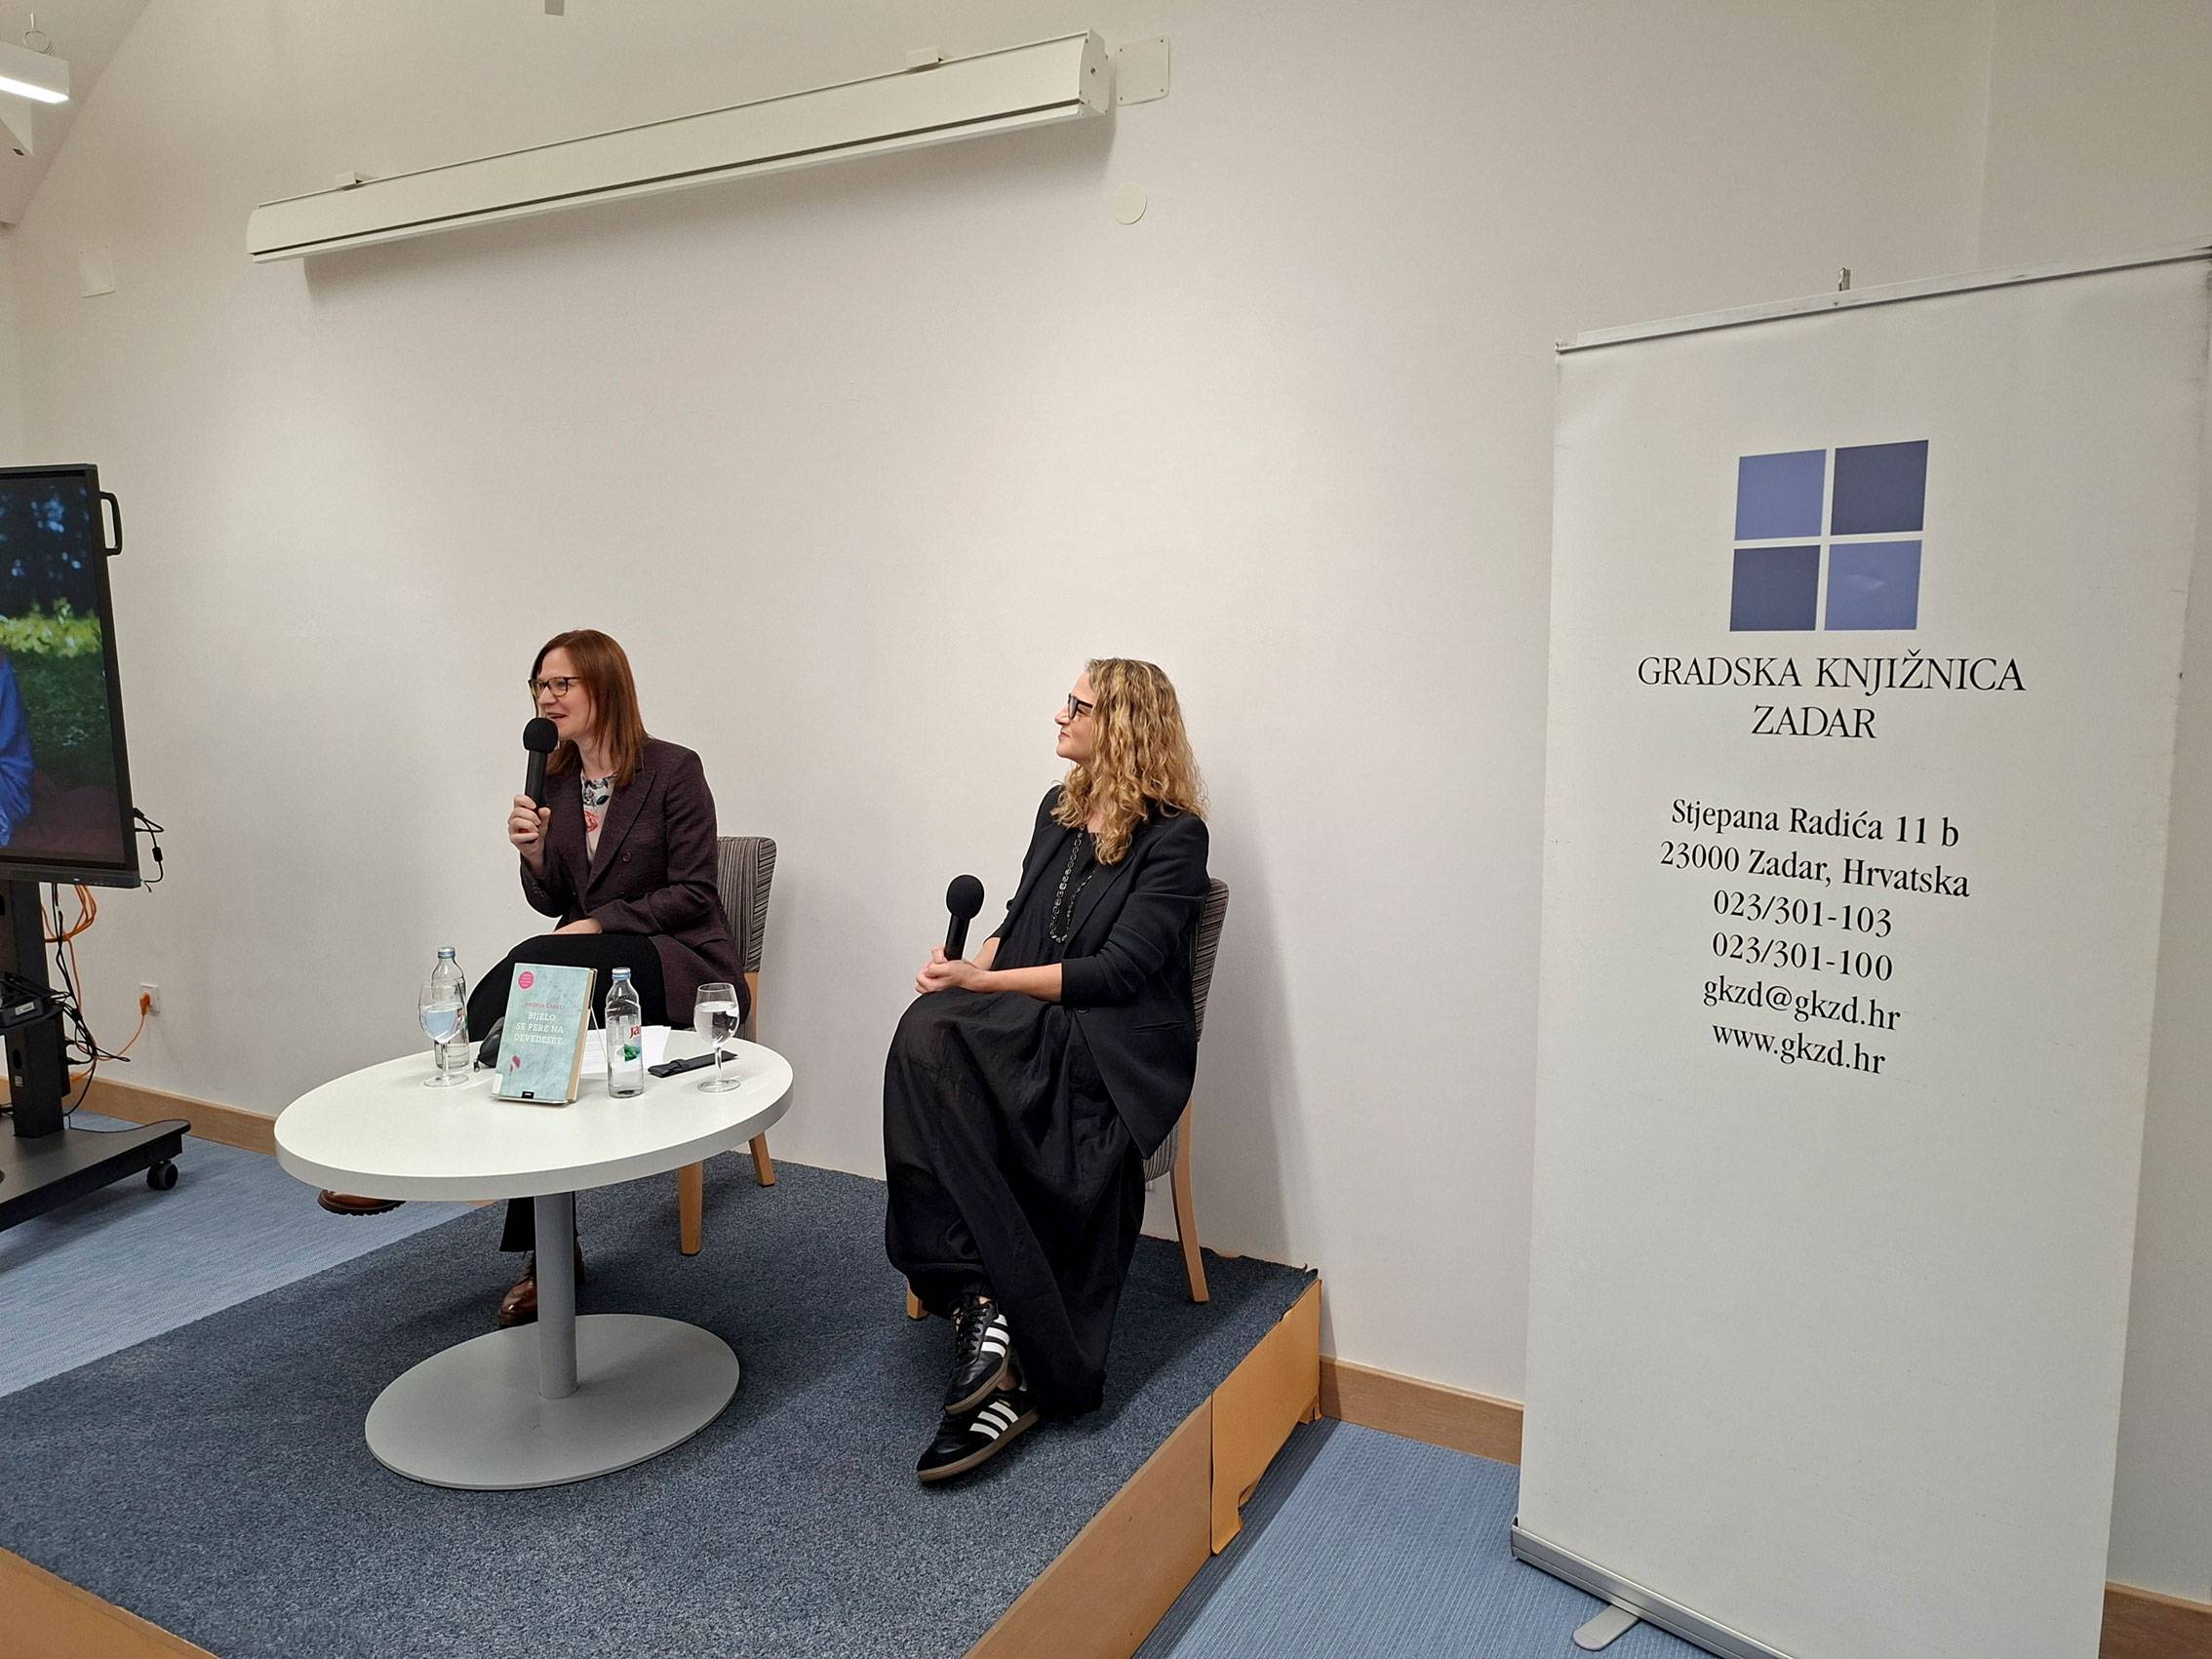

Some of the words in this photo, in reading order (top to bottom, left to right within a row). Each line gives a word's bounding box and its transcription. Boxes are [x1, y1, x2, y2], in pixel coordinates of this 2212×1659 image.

[1638, 656, 1802, 687] GRADSKA
[1814, 649, 2027, 696] KNJIŽNICA
[1752, 705, 1877, 738] ZADAR
[1672, 799, 1780, 834] Stjepana
[1789, 808, 1884, 840] Radića
[1896, 816, 1927, 844] 11
[1941, 817, 1959, 847] b
[1660, 841, 1740, 872] 23000
[1748, 849, 1832, 888] Zadar,
[1842, 858, 1970, 897] Hrvatska
[1714, 889, 1892, 938] 023/301-103
[1712, 932, 1893, 981] 023/301-100
[528, 1011, 556, 1021] BIJELO
[1703, 976, 1902, 1030] gkzd@gkzd.hr
[515, 1022, 526, 1031] SE
[528, 1023, 549, 1033] PERE
[551, 1025, 564, 1034] NA
[628, 1025, 641, 1039] Ja
[1713, 1024, 1886, 1074] www.gkzd.hr
